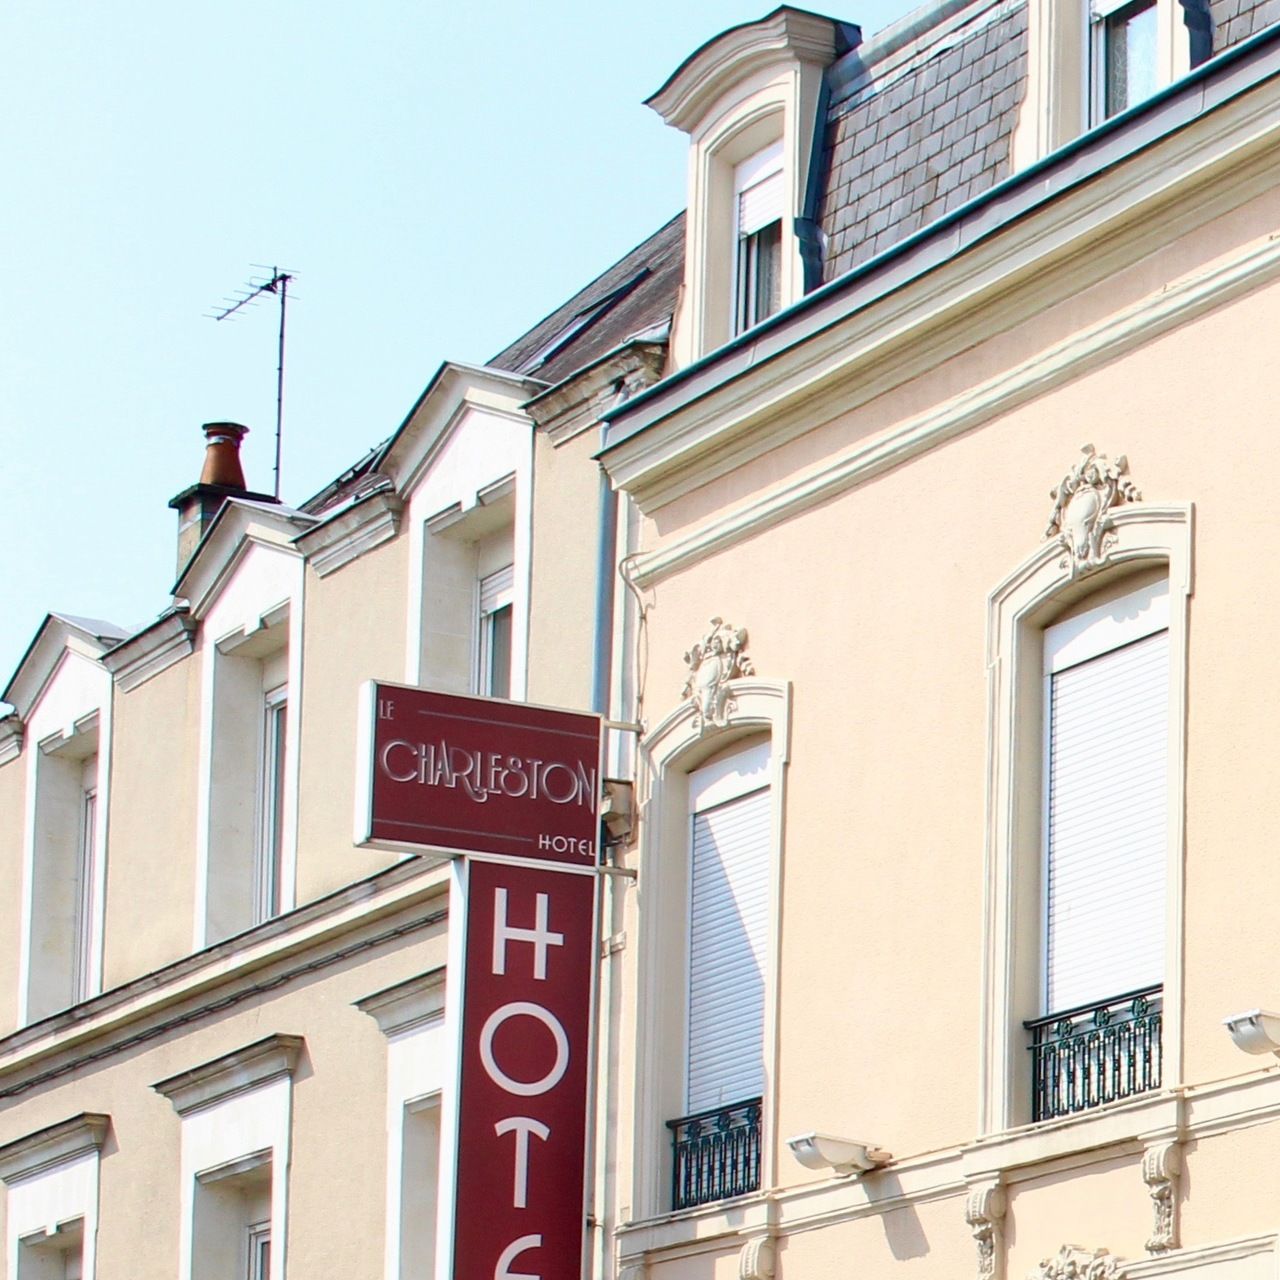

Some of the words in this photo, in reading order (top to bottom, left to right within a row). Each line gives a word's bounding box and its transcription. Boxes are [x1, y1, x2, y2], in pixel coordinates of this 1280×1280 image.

[378, 699, 395, 720] LE
[382, 739, 596, 815] CHARLESTON
[538, 833, 596, 856] HOTEL
